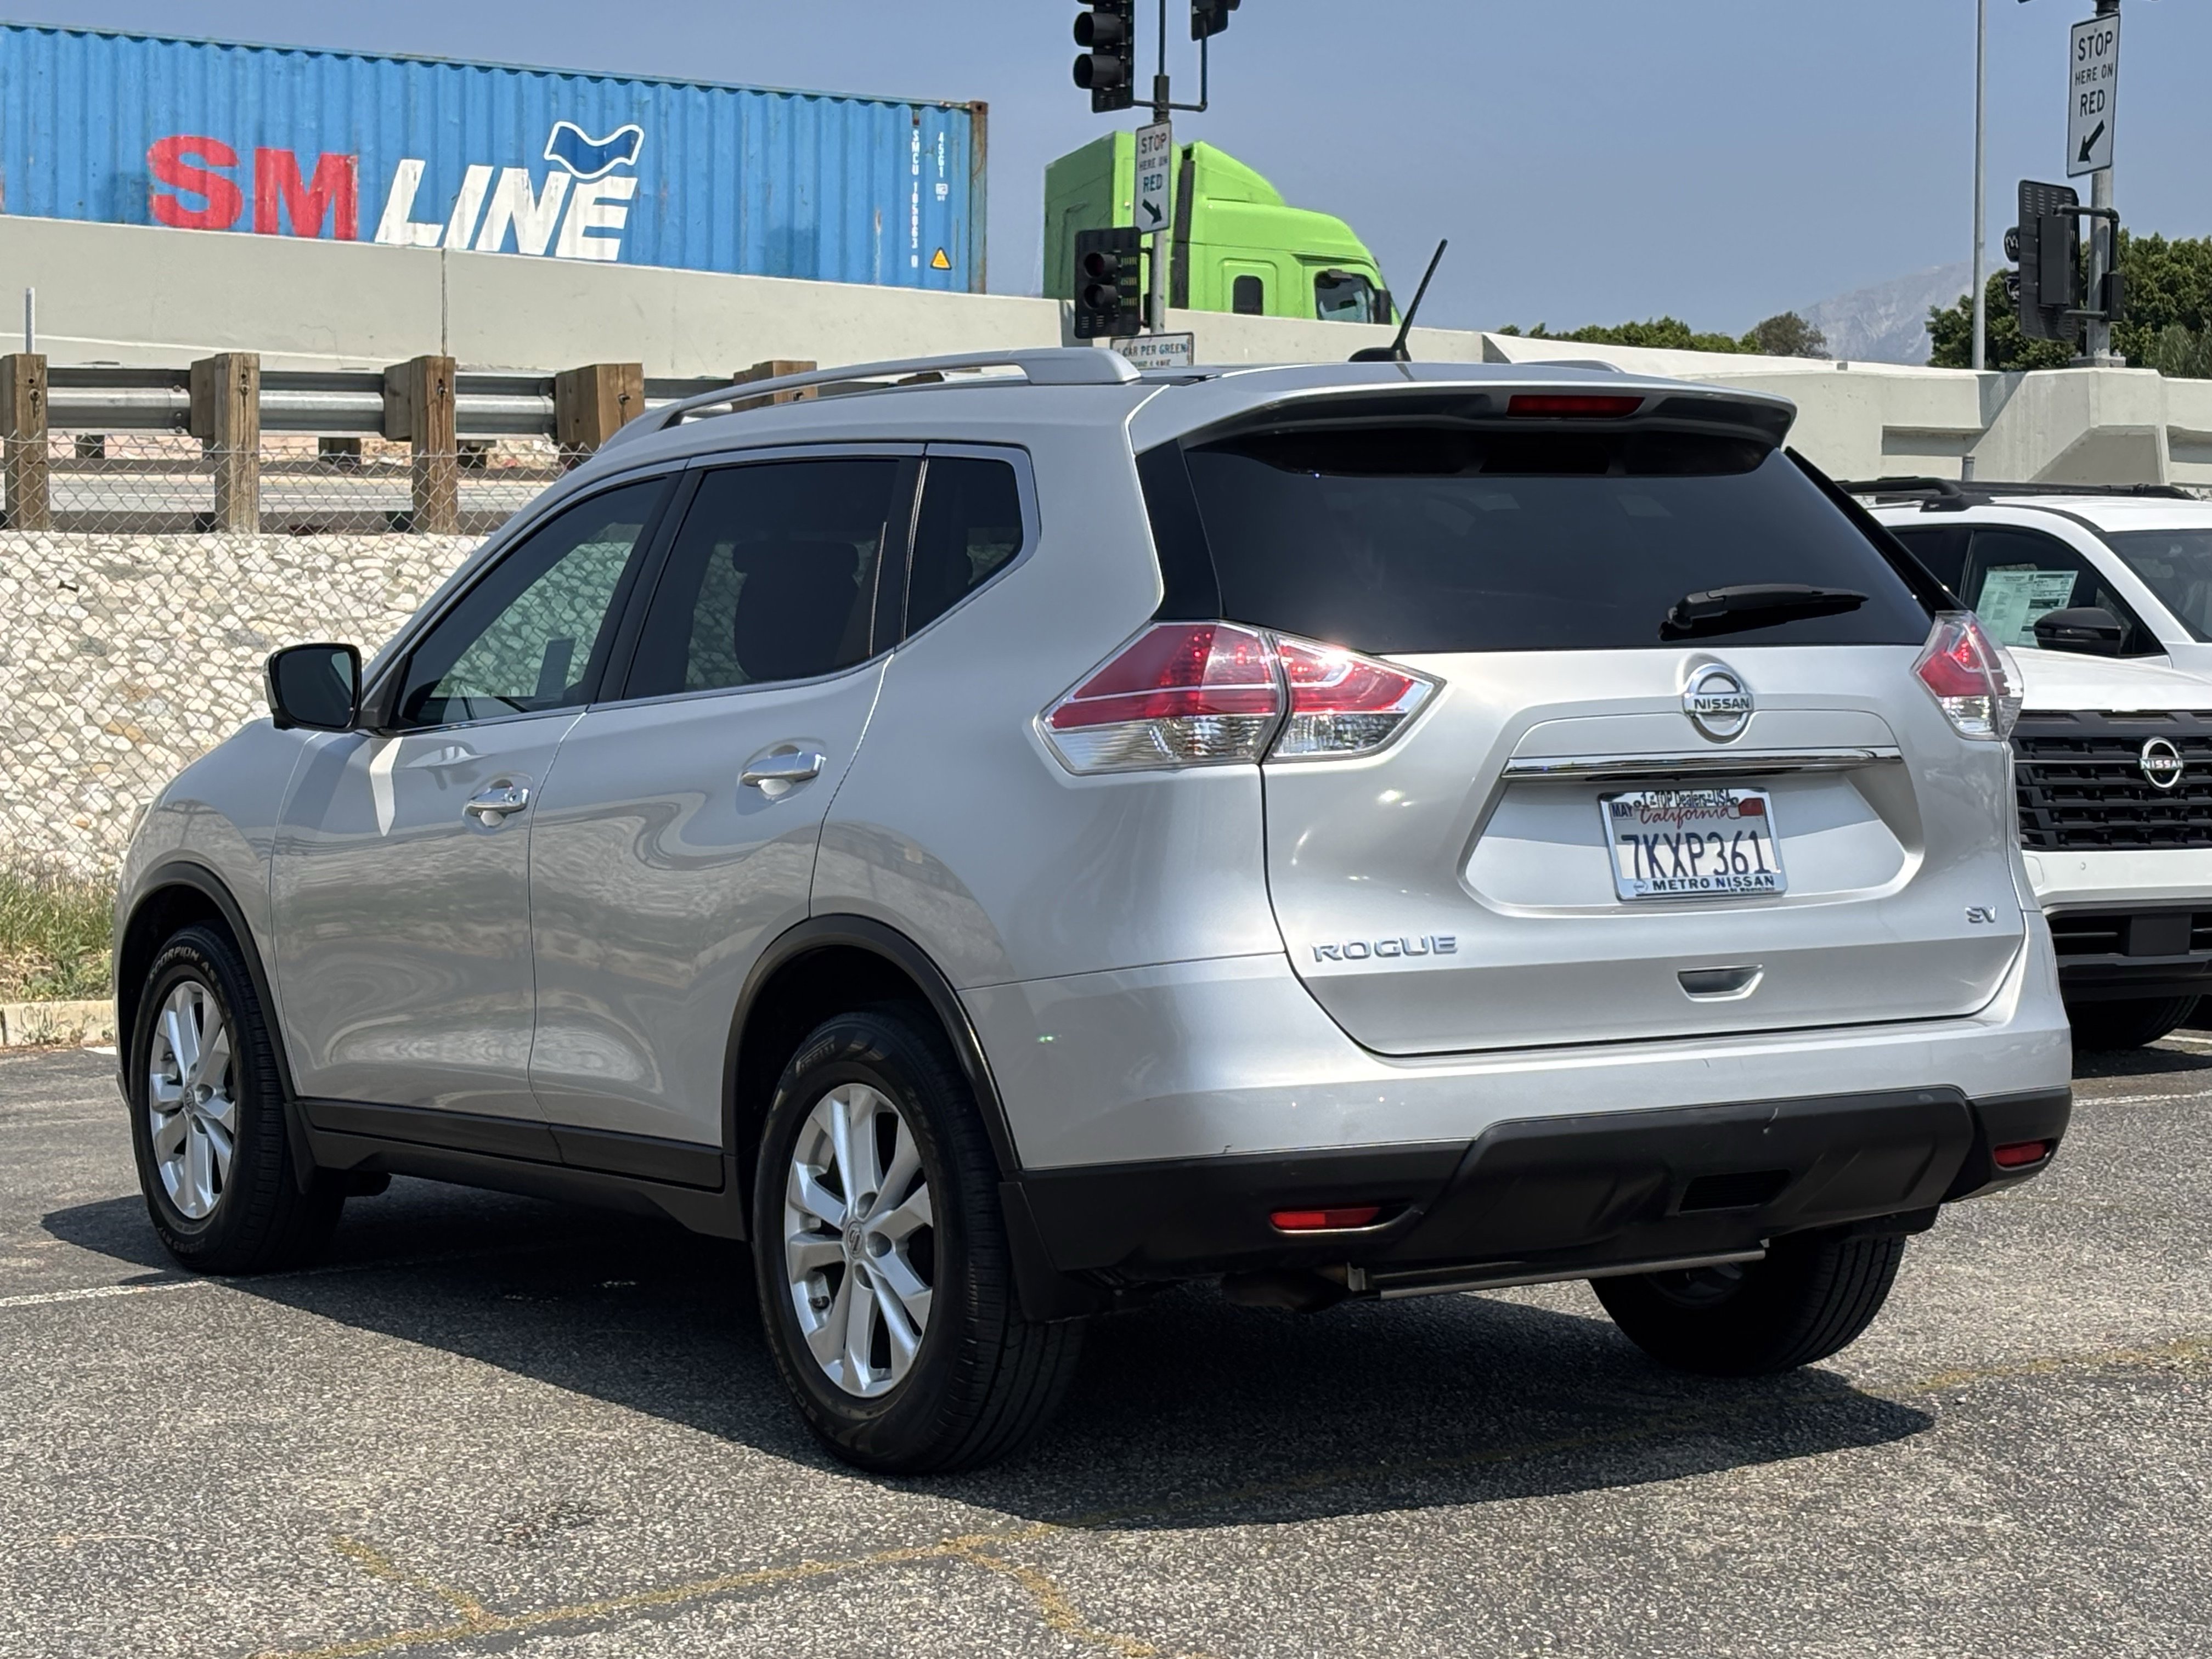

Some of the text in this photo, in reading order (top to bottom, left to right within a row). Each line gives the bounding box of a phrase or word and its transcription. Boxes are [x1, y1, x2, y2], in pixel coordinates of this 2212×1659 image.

[2078, 30, 2113, 61] STOP
[2075, 63, 2113, 86] HERE ON
[2079, 89, 2105, 117] RED
[911, 129, 920, 176] SMCU
[1141, 133, 1166, 154] STOP
[1139, 158, 1156, 171] HERE
[1143, 173, 1163, 193] RED
[147, 135, 637, 262] SM LINE
[1122, 346, 1138, 357] CAR
[1141, 345, 1156, 356] PER
[1159, 343, 1188, 354] GREEN
[1694, 697, 1750, 710] NISSAN
[2140, 759, 2183, 770] NISSAN
[1612, 804, 1633, 817] MAY
[1640, 807, 1741, 830] California
[1621, 830, 1771, 880] 7KXP361
[1652, 876, 1775, 891] METRO NISSAN
[1965, 905, 1996, 924] SV
[1310, 934, 1458, 962] ROGUE
